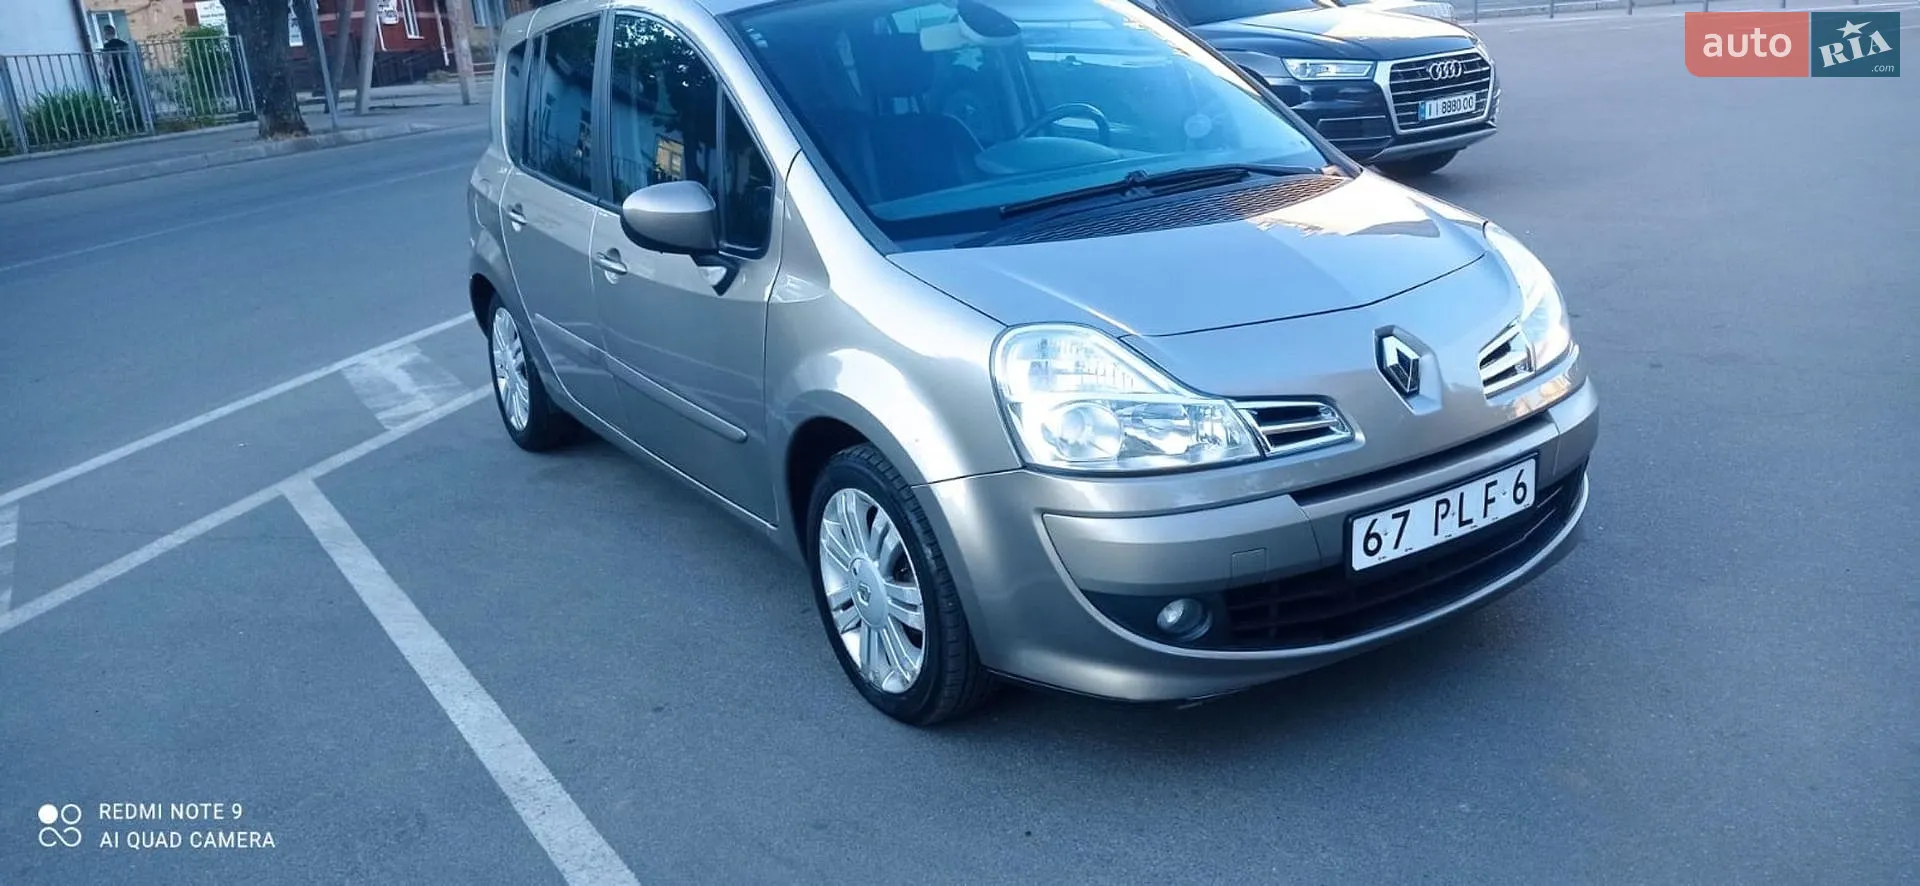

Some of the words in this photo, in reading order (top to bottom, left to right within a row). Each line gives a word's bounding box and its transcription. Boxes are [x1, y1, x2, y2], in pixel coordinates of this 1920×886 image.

[1363, 509, 1411, 557] 67
[1433, 479, 1498, 537] PLF
[1512, 469, 1528, 505] 6
